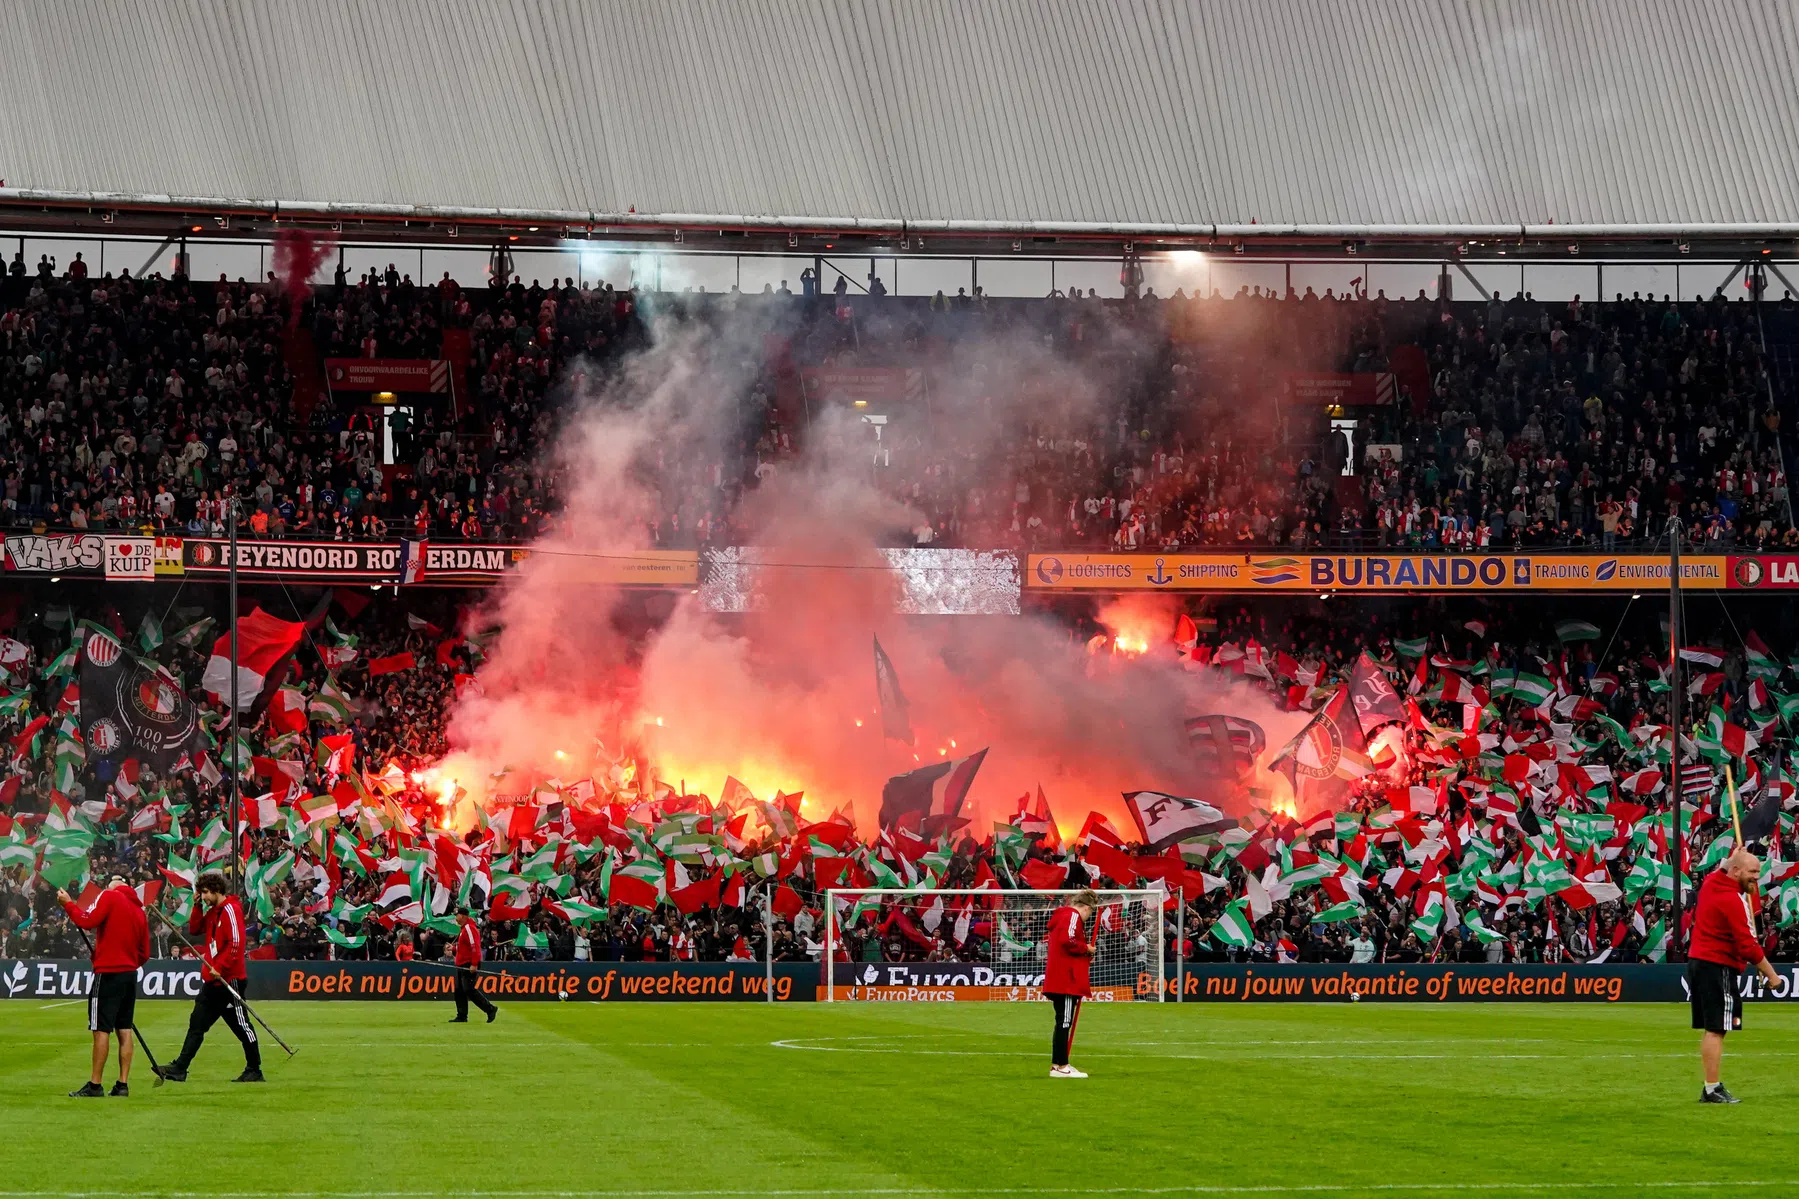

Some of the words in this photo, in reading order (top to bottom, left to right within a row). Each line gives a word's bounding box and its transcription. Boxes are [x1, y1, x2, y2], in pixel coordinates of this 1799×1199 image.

[350, 376, 375, 384] TROUW
[110, 545, 115, 556] I
[135, 545, 151, 556] DE
[221, 545, 357, 569] FEYENOORD
[367, 549, 505, 570] ROERDAM
[110, 557, 151, 572] KUIP
[637, 563, 671, 571] eesteren
[1069, 564, 1132, 577] LOGISTICS
[1179, 564, 1238, 578] SHIPPING
[1310, 557, 1507, 586] BURANDO
[1535, 564, 1589, 578] TRADING
[135, 725, 162, 743] 100
[132, 736, 159, 754] JAAR
[288, 968, 353, 993] Boek
[360, 974, 391, 993] nu
[587, 970, 617, 999] of
[620, 970, 735, 994] weekend
[742, 976, 792, 1000] weg
[1136, 971, 1199, 994] Boek
[1206, 976, 1236, 994] nu
[1242, 970, 1305, 1000] jouw
[1311, 970, 1419, 995] vakantie
[1425, 972, 1452, 1000] of
[1458, 971, 1567, 995] weekend
[1574, 976, 1623, 1000] weg
[866, 987, 954, 1001] EuroParcs
